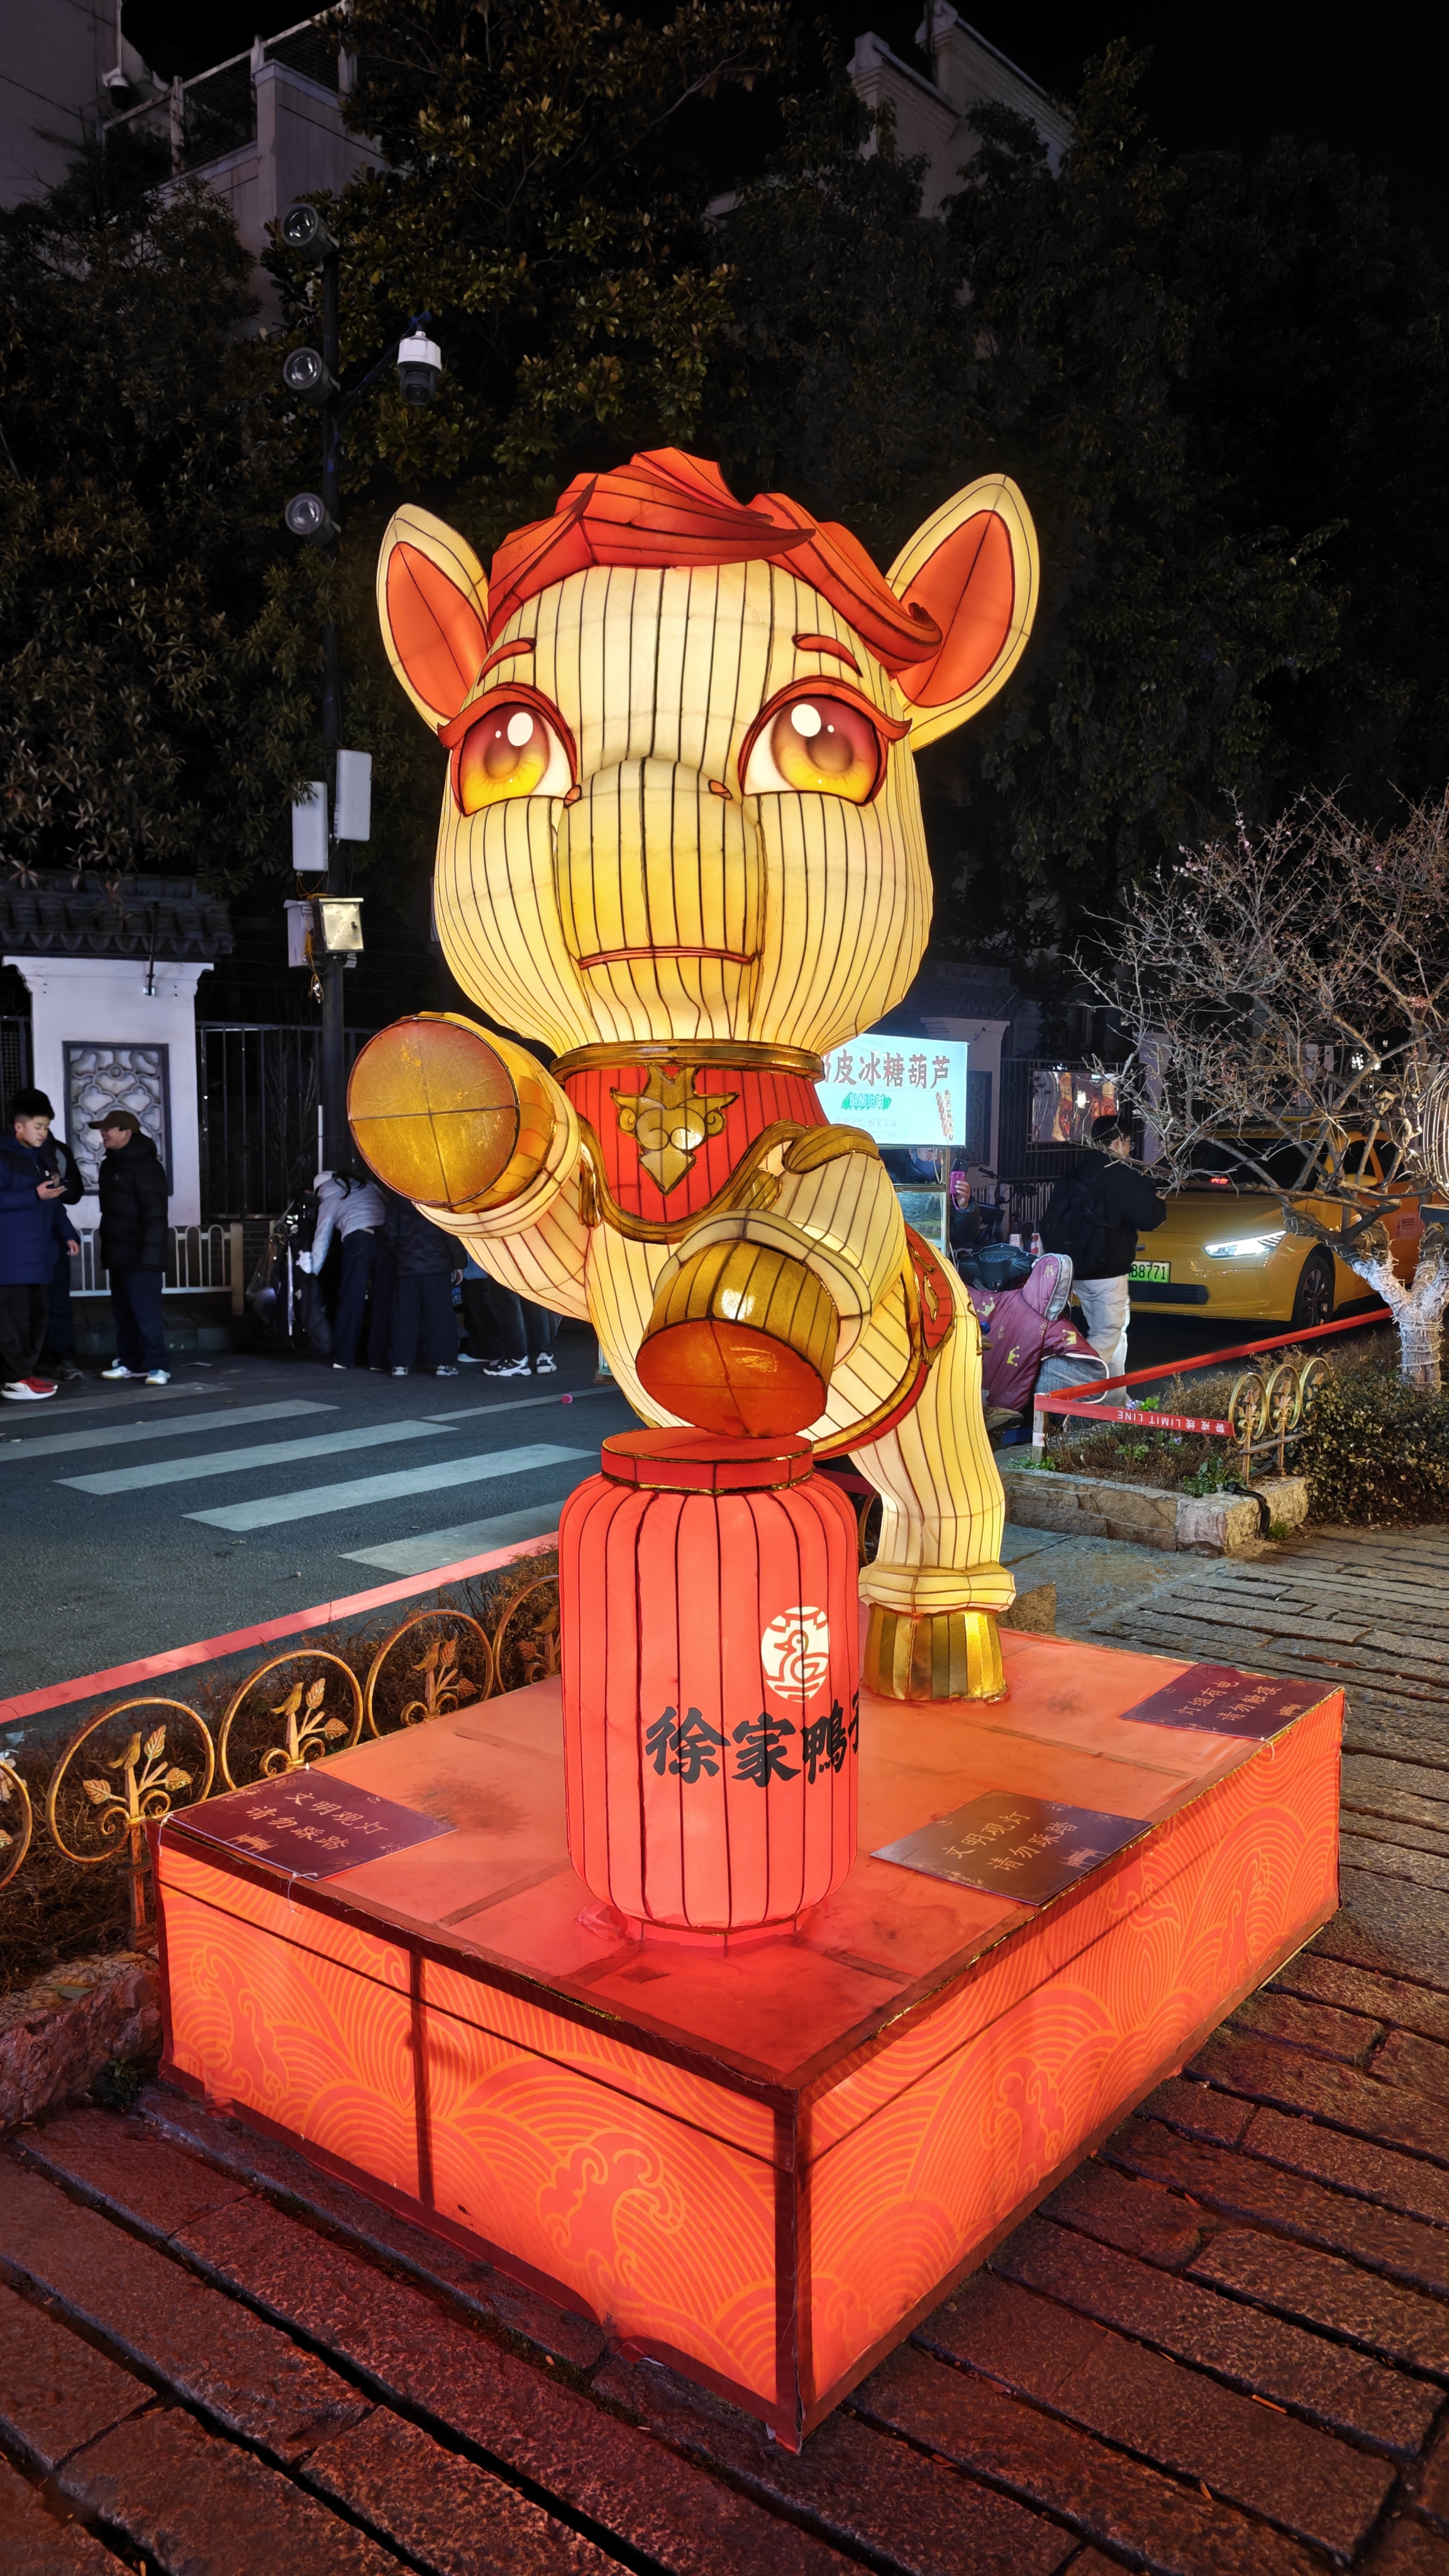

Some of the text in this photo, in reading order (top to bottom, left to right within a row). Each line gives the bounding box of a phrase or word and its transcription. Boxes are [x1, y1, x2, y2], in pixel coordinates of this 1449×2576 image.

[849, 1094, 884, 1107] 酸酸甜甜
[1129, 1263, 1165, 1280] B8771
[1118, 1411, 1225, 1433] 警戒线 LIMIT LINE
[1173, 1680, 1240, 1716] 灯组有电
[1216, 1685, 1282, 1721] 请勿触摸
[245, 1806, 350, 1851] 请勿踩踏
[284, 1792, 389, 1835] 文明观灯
[941, 1811, 1032, 1859] 文明观灯
[986, 1821, 1079, 1871] 请勿踩踏
